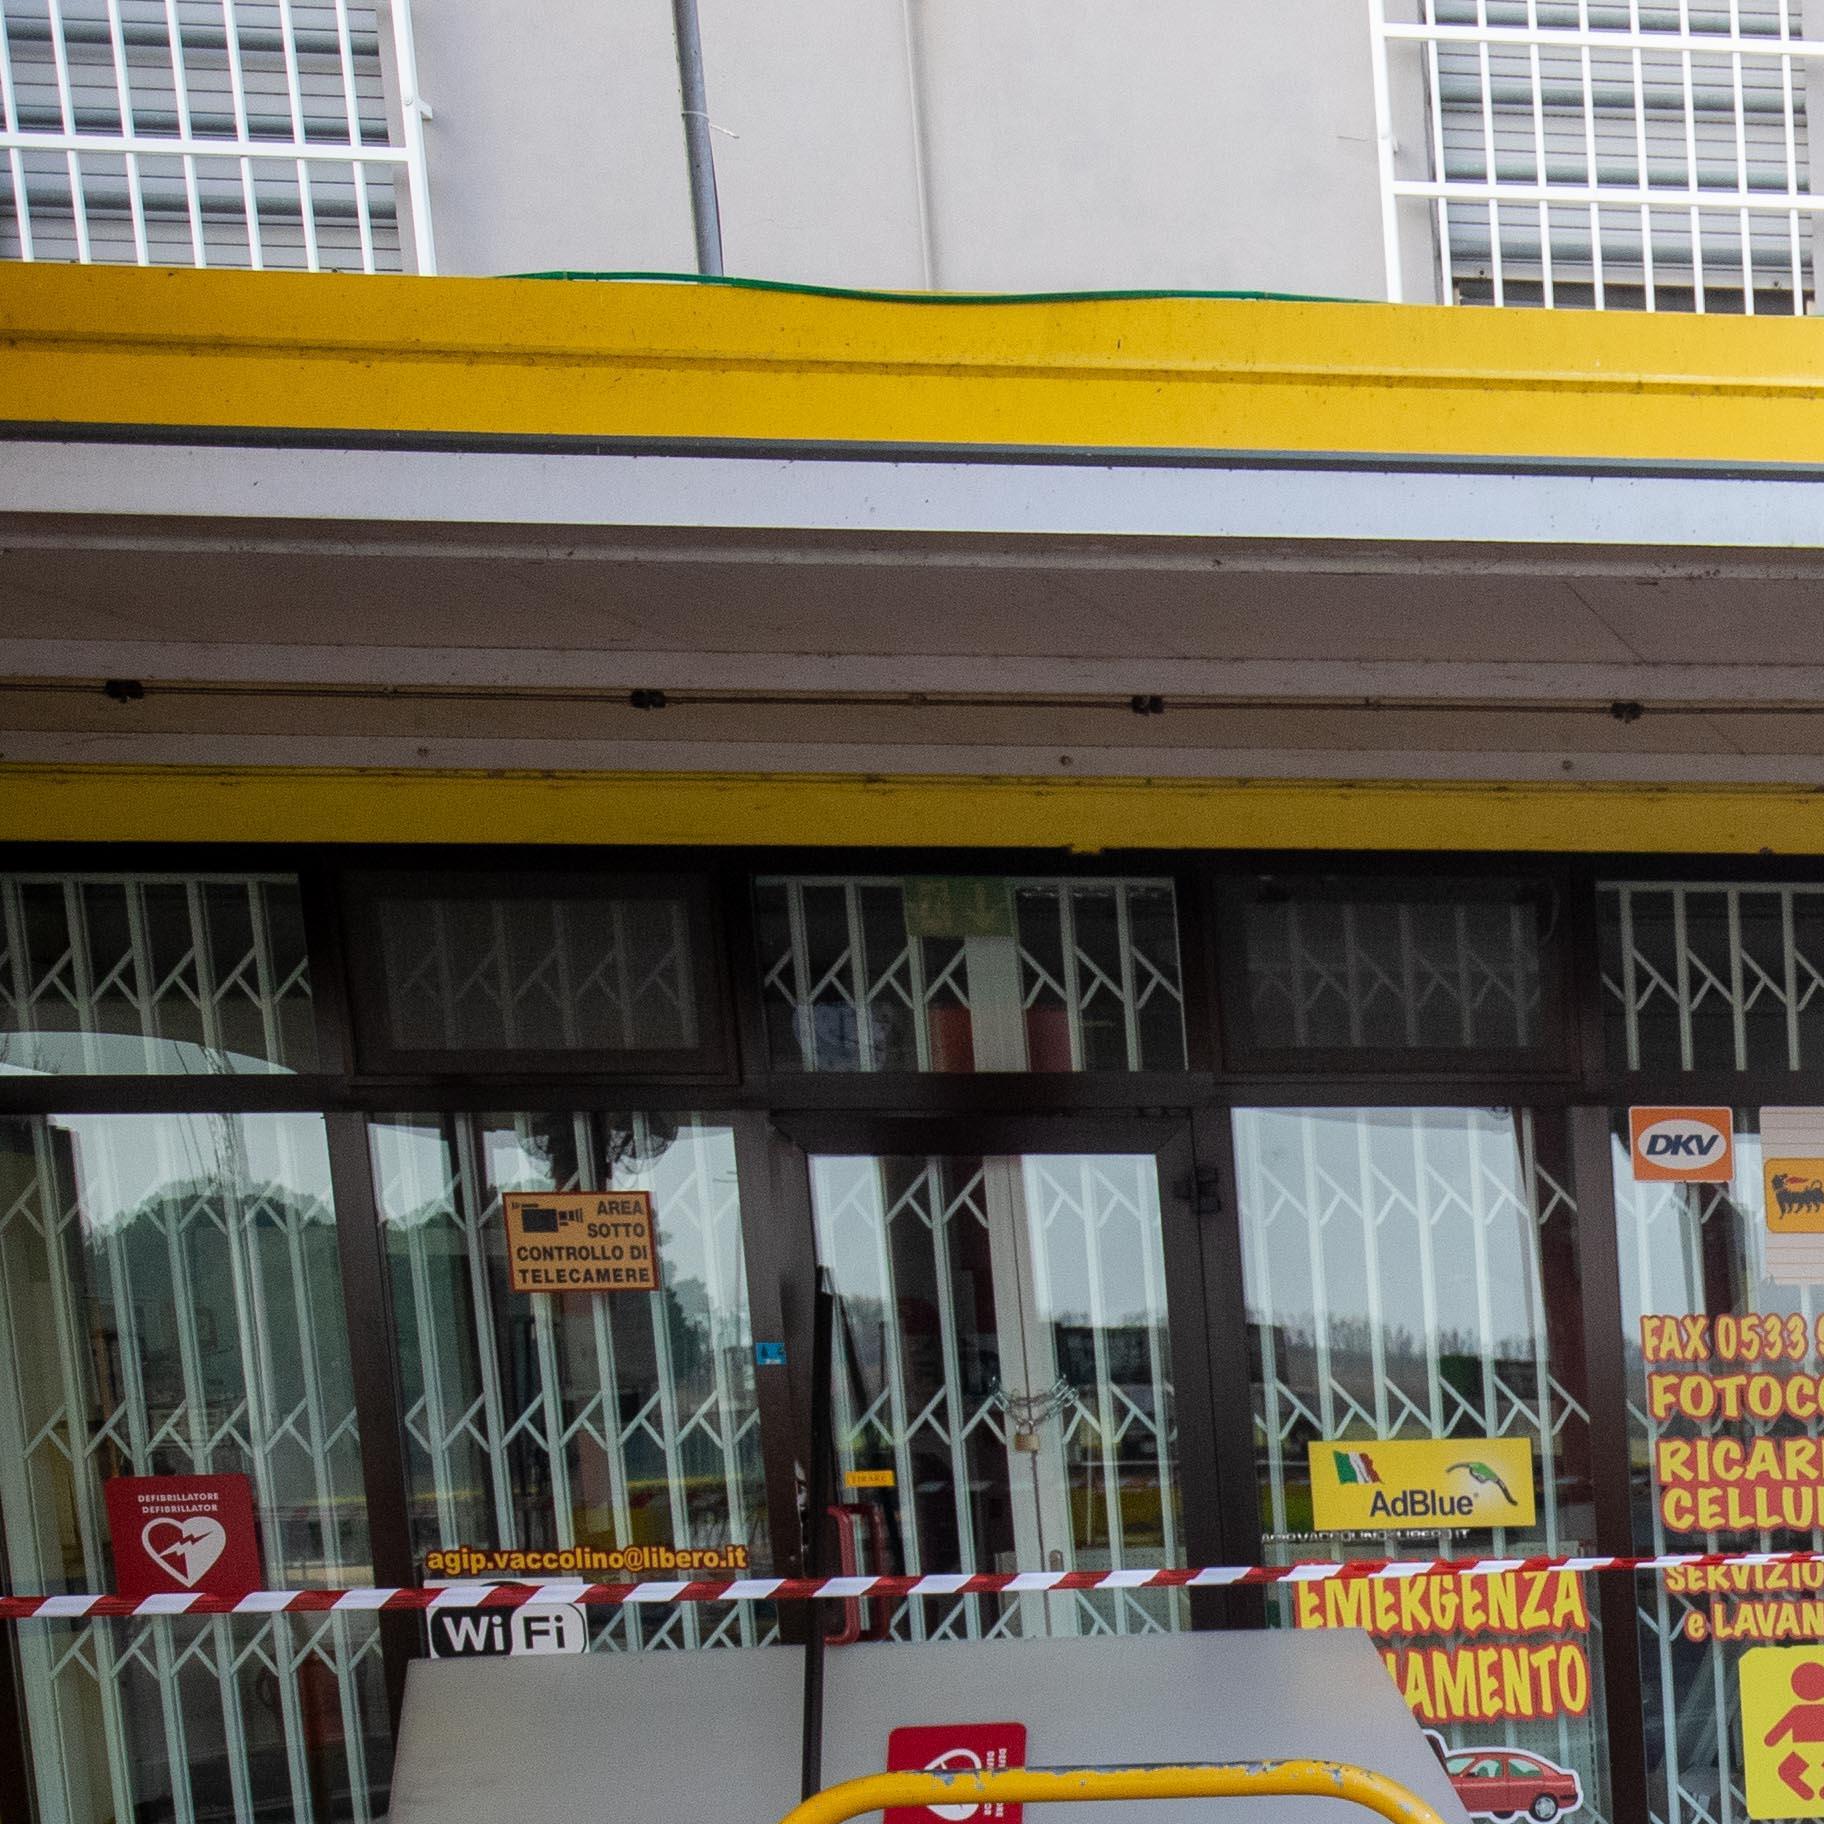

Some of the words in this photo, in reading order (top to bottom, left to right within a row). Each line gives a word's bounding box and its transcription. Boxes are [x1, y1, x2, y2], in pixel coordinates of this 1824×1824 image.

[1646, 1133, 1720, 1157] DKV
[597, 1200, 644, 1215] AREA
[587, 1222, 645, 1239] SOTTO
[516, 1245, 624, 1262] CONTROLLO
[629, 1245, 648, 1260] DI
[517, 1267, 650, 1284] TELECAMERE
[1642, 1315, 1708, 1360] FAX
[1716, 1314, 1806, 1360] 0533
[138, 1492, 219, 1503] DEFIBRILLATORE
[1369, 1489, 1474, 1518] AdBlue
[142, 1503, 219, 1514] DEFIBRILLATOR
[427, 1546, 749, 1576] agip.vaccolino@libero.it
[1687, 1611, 1707, 1640] e
